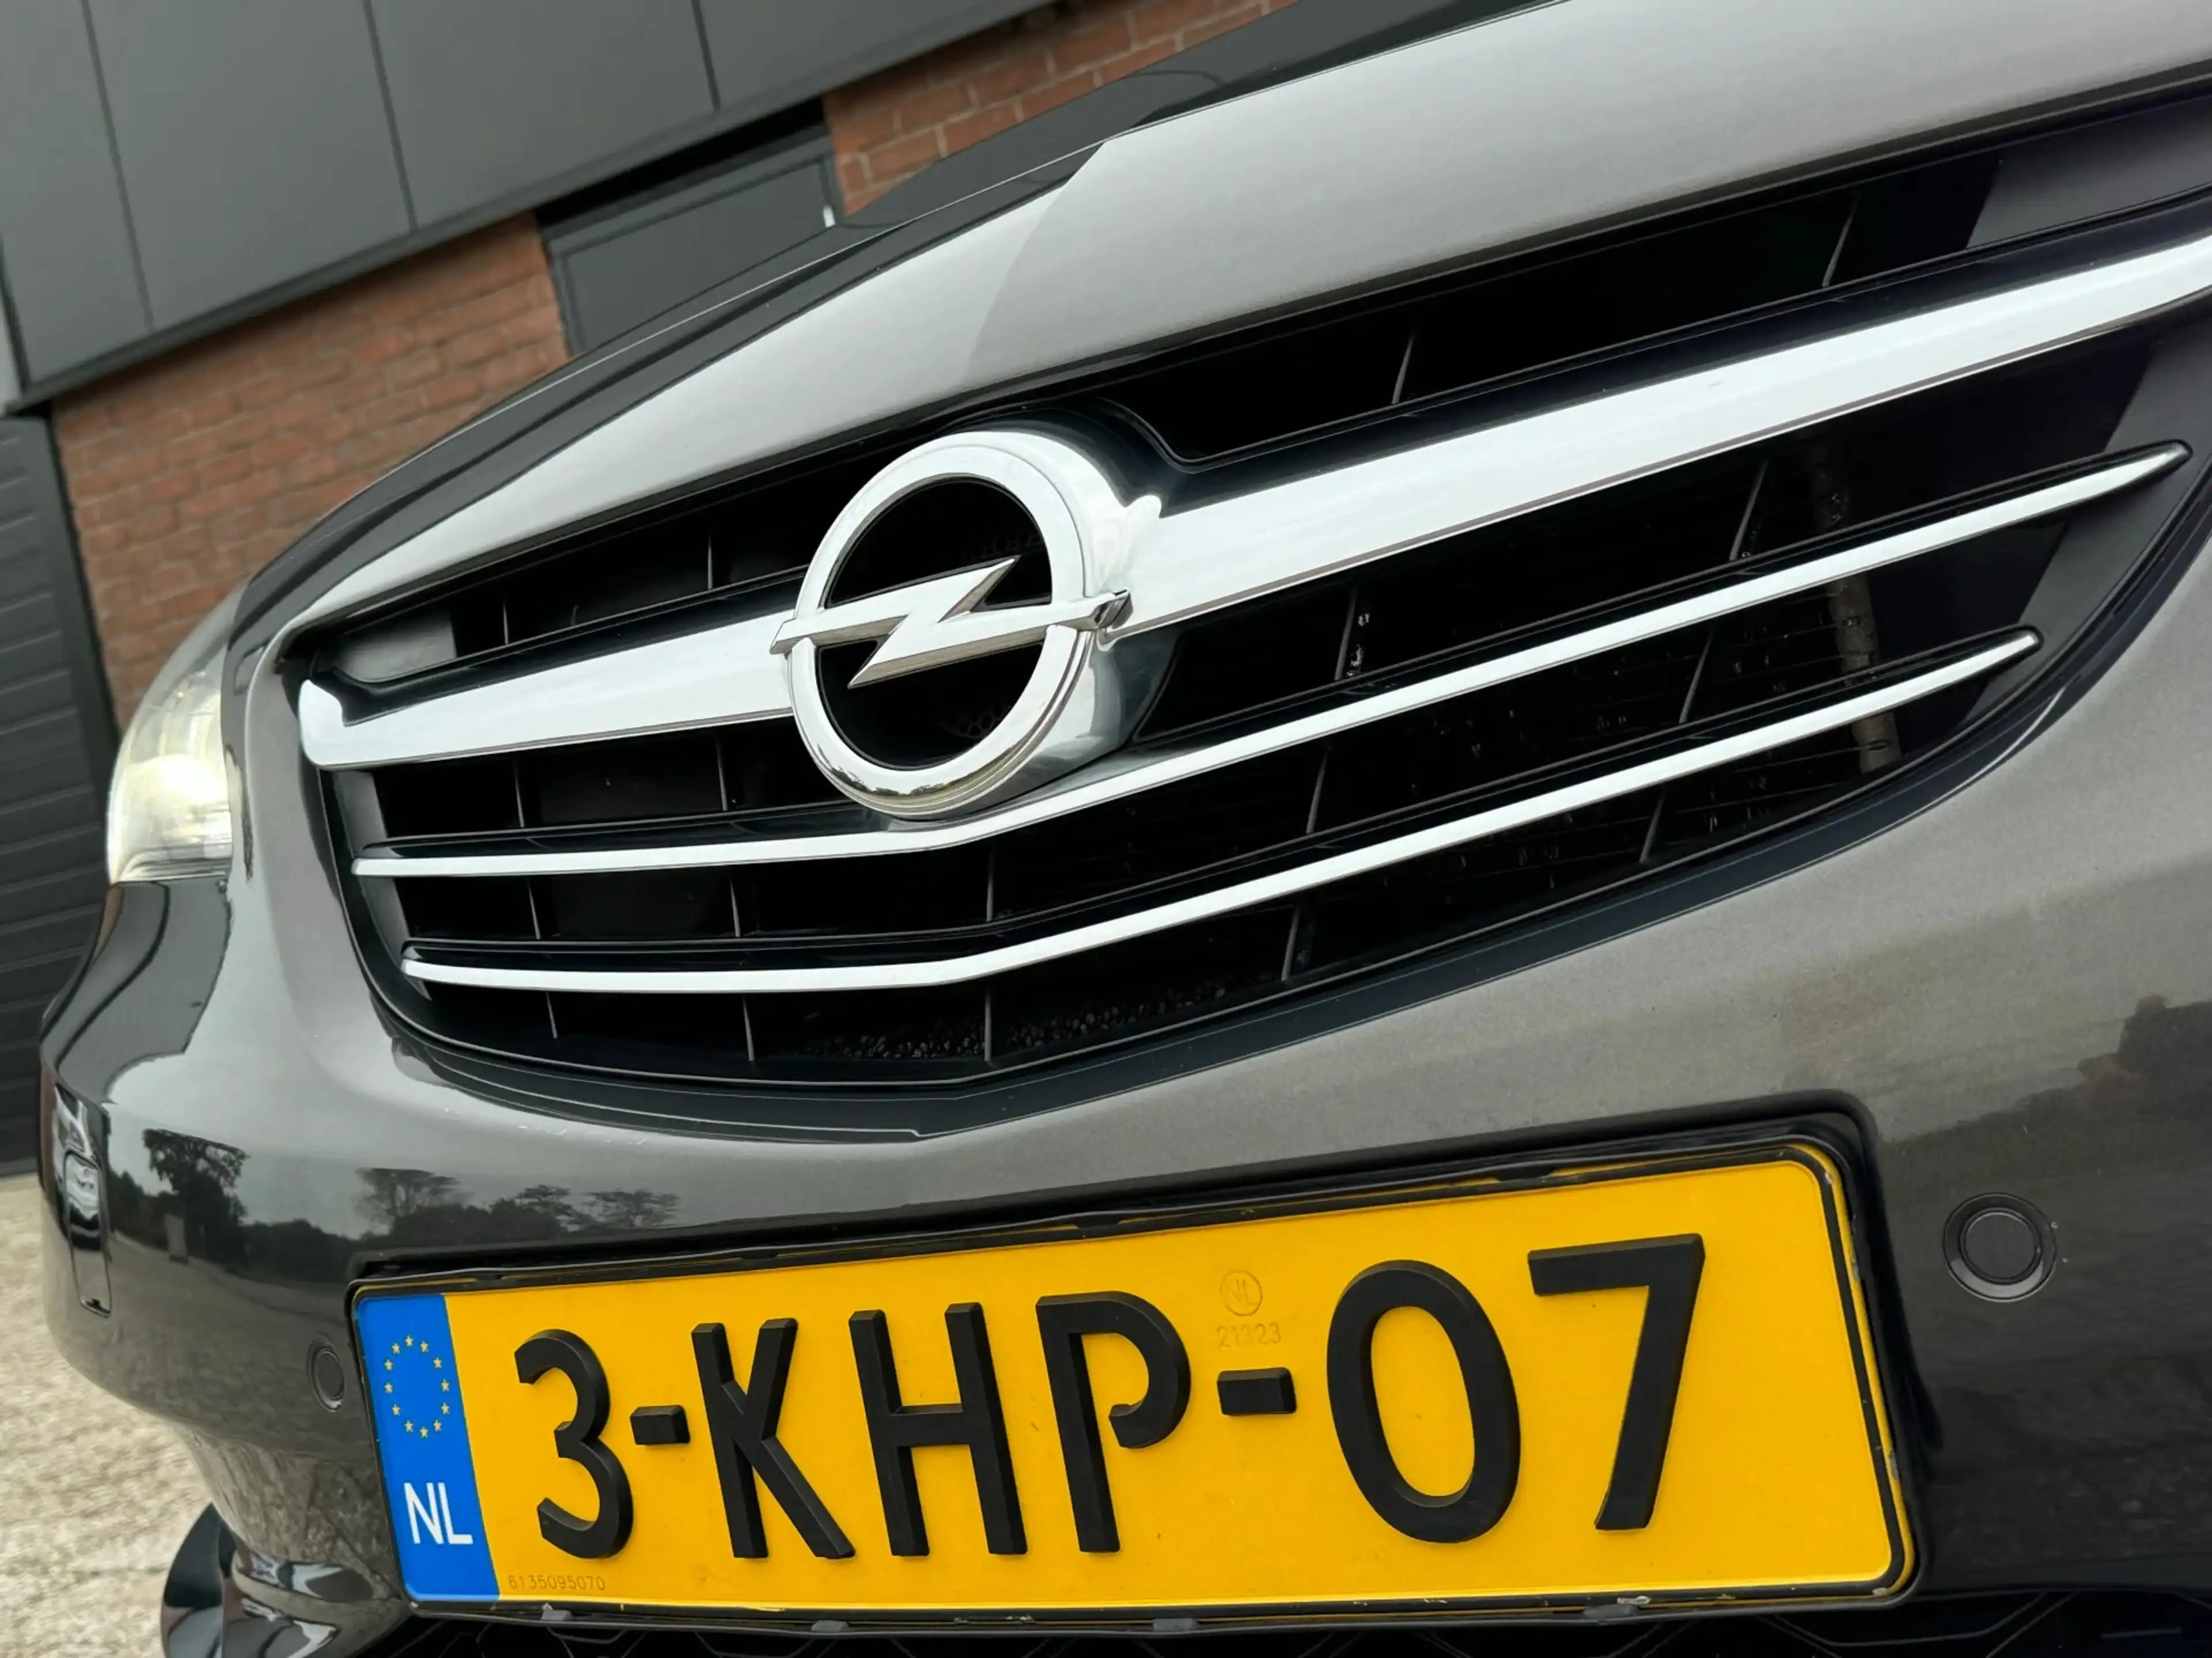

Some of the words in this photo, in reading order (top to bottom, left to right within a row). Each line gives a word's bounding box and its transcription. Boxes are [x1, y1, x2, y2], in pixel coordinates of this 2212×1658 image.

[1222, 1276, 1262, 1307] NL
[514, 1234, 1705, 1560] 3-KHP-07
[404, 1482, 473, 1545] NL
[508, 1574, 606, 1591] 6135095070
